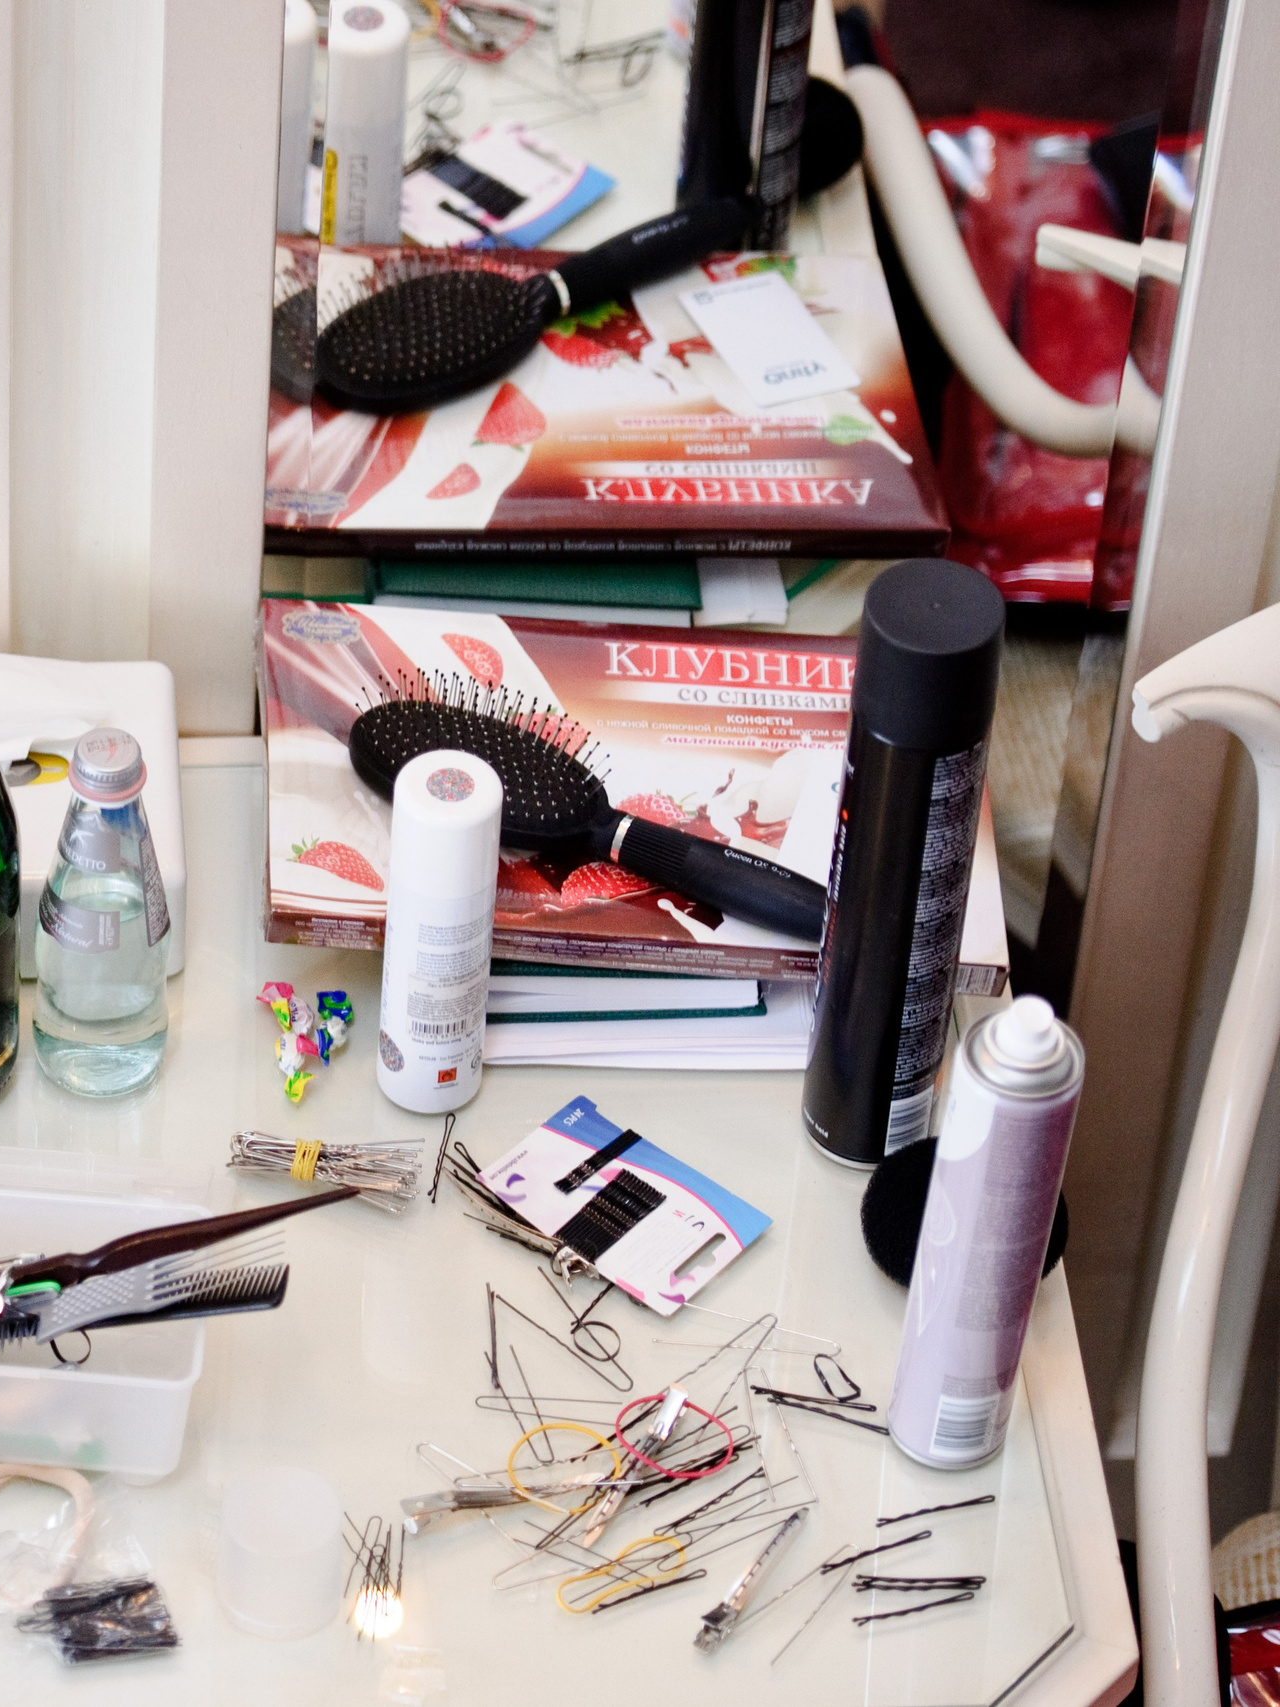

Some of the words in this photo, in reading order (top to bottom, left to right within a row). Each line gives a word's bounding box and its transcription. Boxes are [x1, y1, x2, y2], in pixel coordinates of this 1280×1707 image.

[726, 714, 793, 726] КОНФЕТЫ
[664, 734, 756, 747] маленький
[763, 738, 825, 752] кусочек
